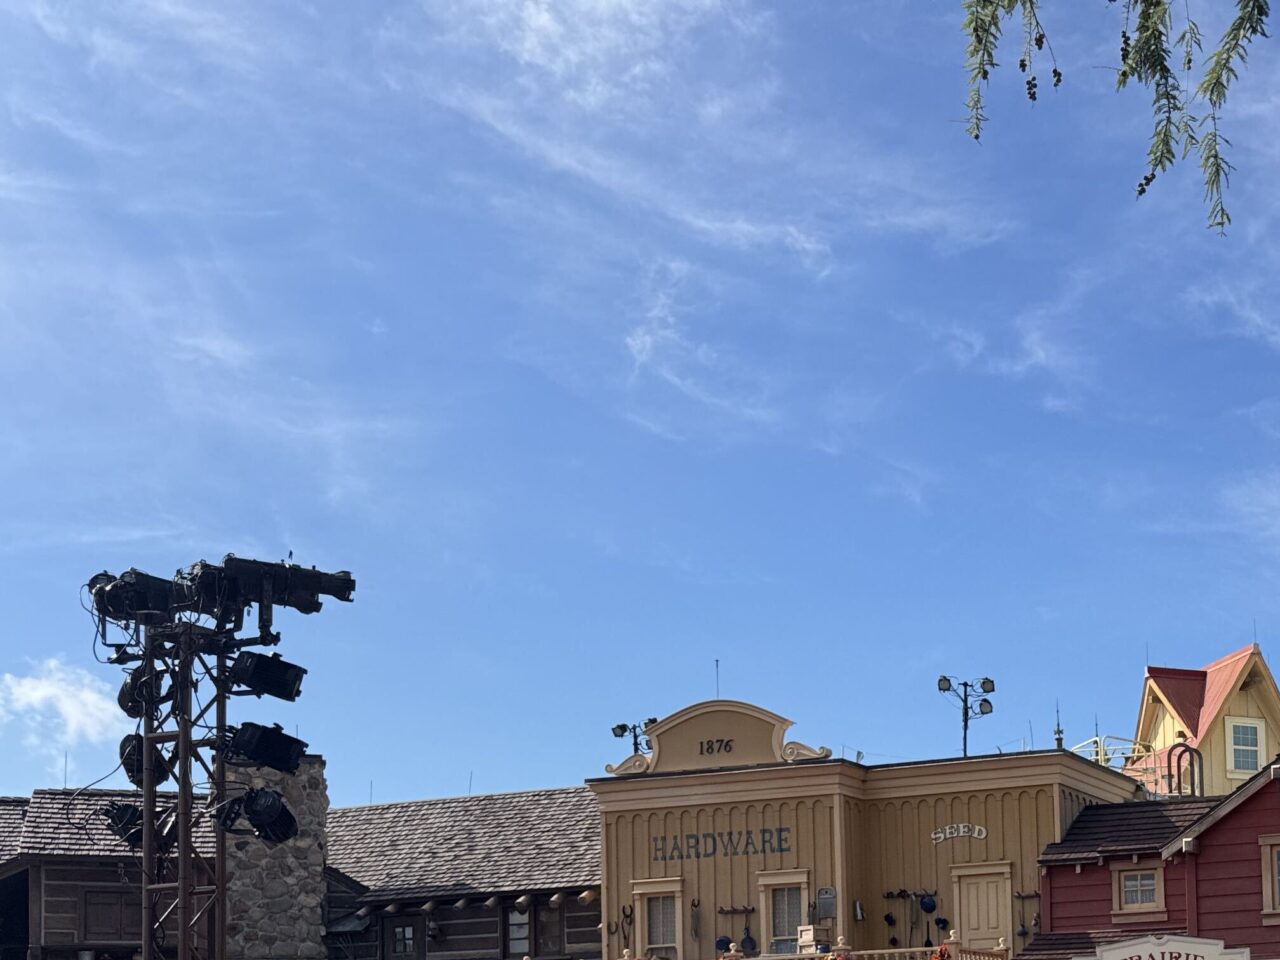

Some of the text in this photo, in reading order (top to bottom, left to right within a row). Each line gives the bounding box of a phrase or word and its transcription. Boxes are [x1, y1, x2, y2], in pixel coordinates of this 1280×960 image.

[698, 738, 733, 755] 1876
[652, 826, 791, 862] HARDWARE
[930, 823, 988, 845] SEED
